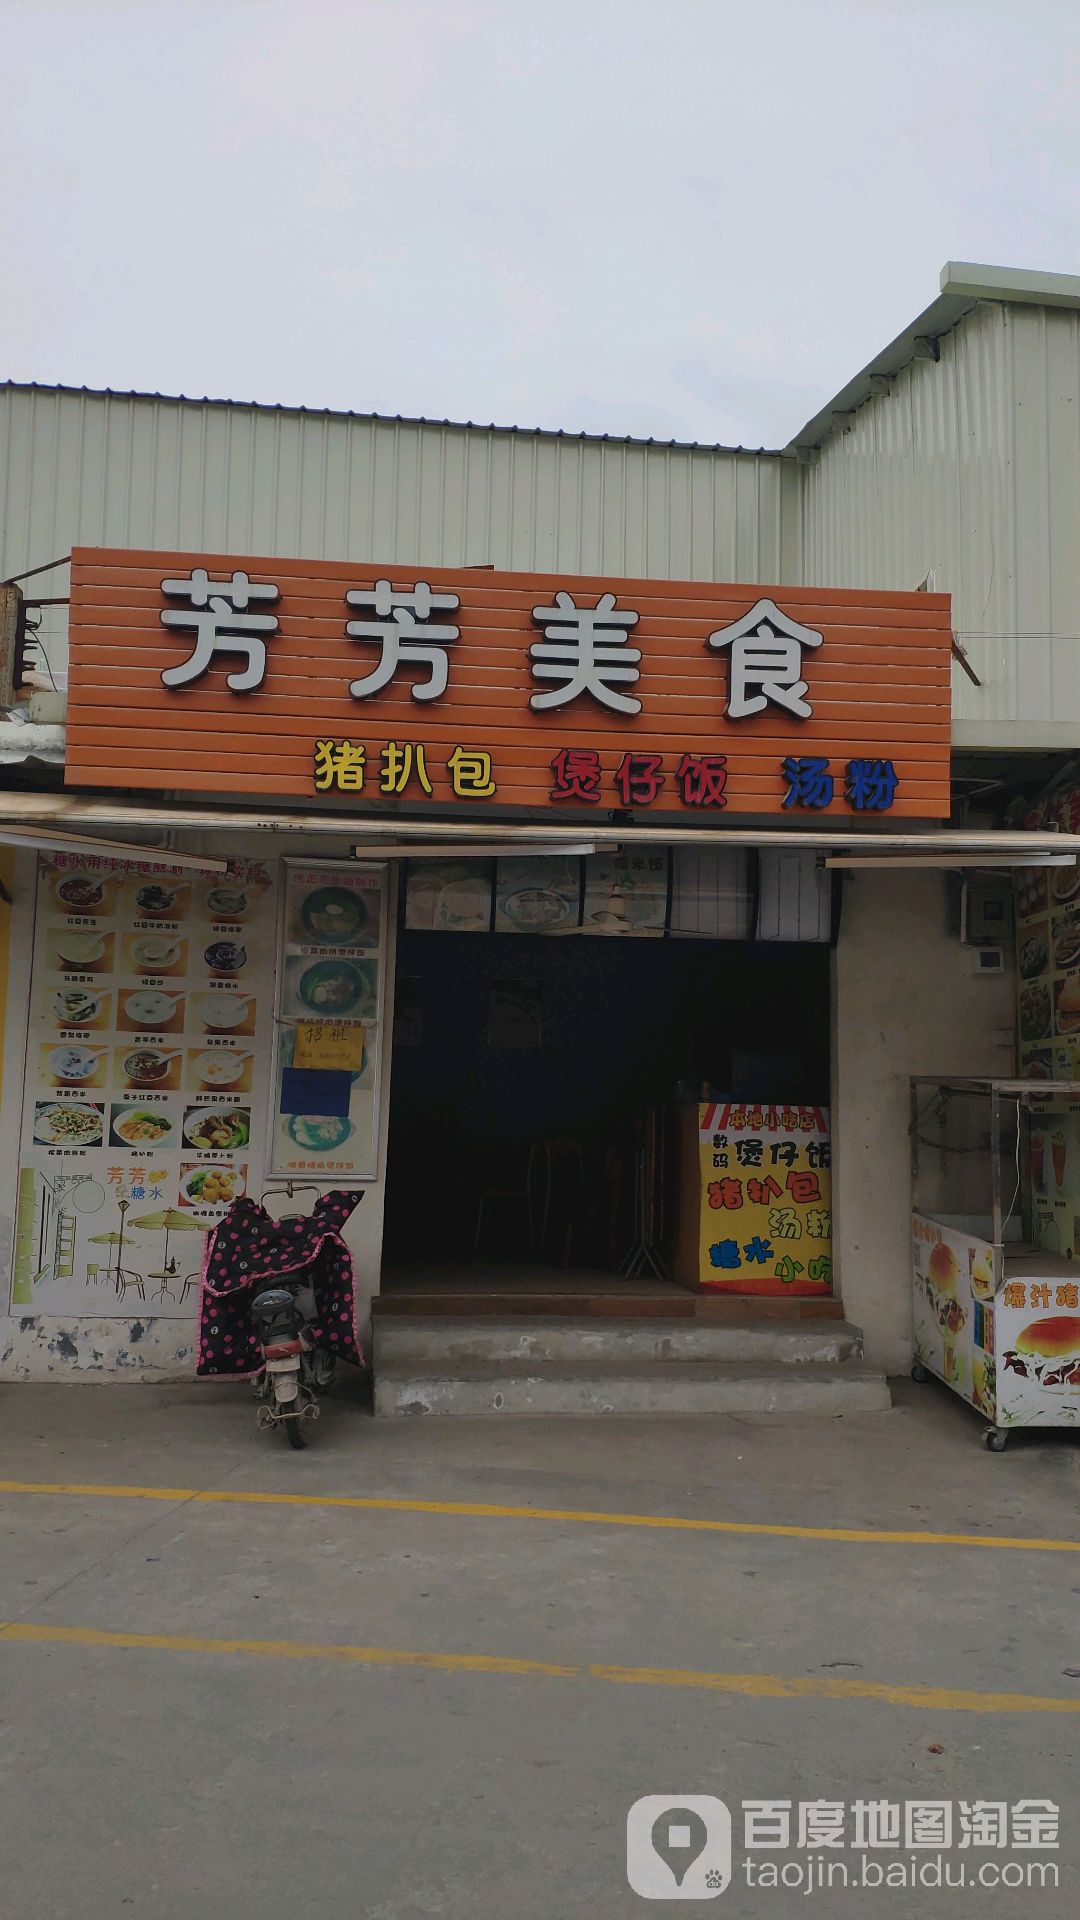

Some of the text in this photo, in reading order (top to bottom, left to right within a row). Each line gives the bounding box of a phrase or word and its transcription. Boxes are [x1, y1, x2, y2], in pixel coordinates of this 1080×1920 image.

[159, 568, 825, 721] 芳芳美食
[313, 738, 900, 813] 猪扒包 煲仔饭 汤粉
[728, 1110, 816, 1130] 本地小吃店
[713, 1134, 728, 1168] 数码
[107, 1166, 147, 1185] 芳芳
[707, 1170, 821, 1210] 猪扒包
[130, 1186, 163, 1201] 糖水
[709, 1236, 774, 1269] 糖水
[1003, 1281, 1080, 1309] 爆汁猪
